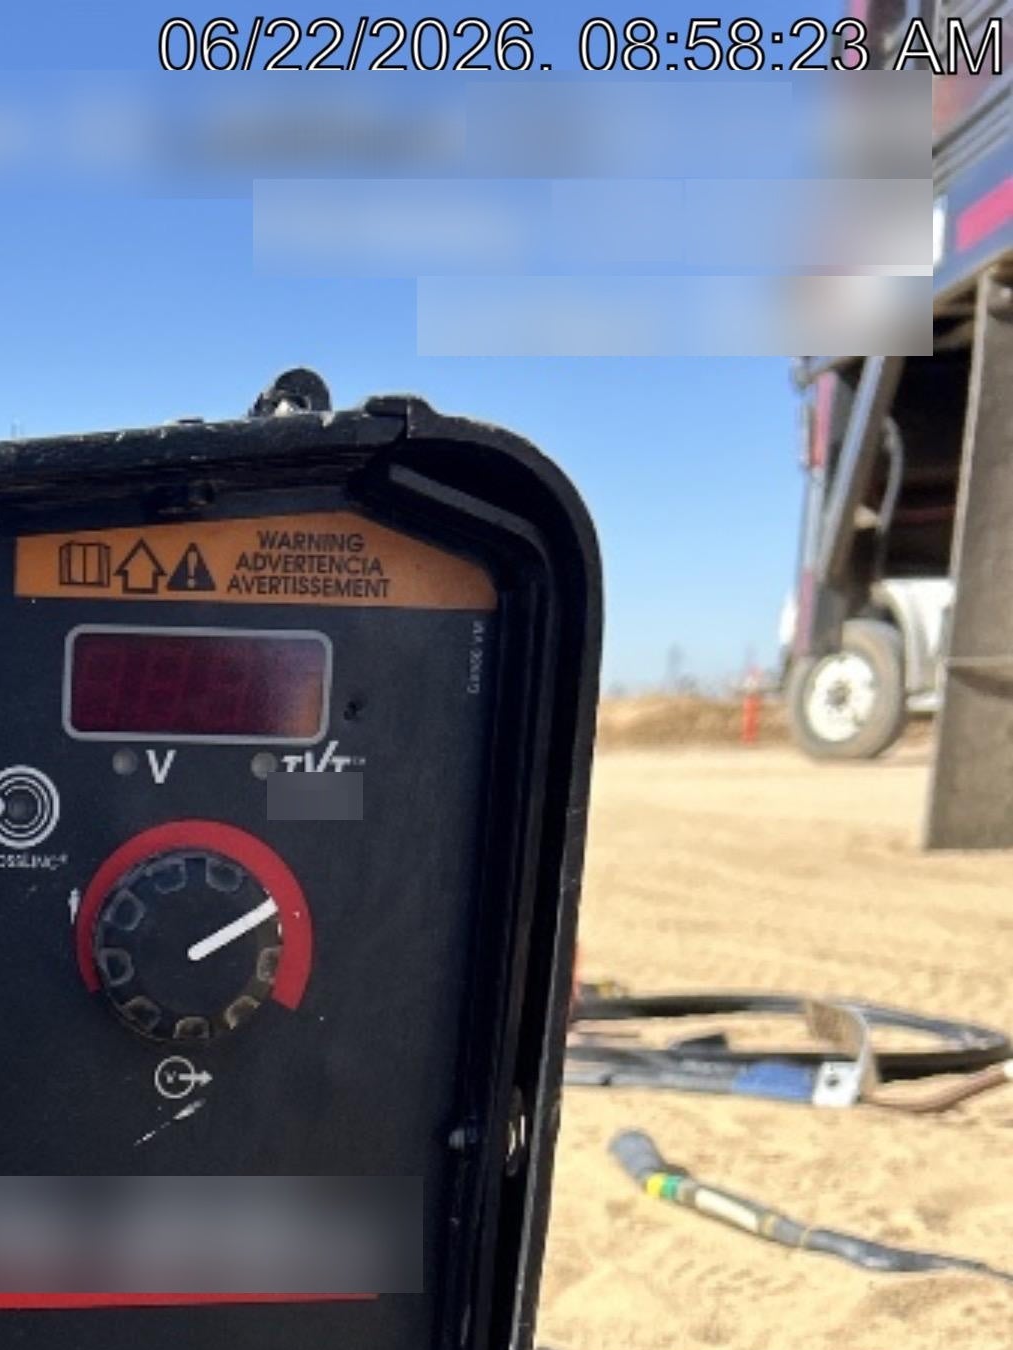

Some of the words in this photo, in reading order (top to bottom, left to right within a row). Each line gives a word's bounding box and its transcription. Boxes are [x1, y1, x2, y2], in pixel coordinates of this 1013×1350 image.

[258, 531, 364, 552] WARNING
[235, 552, 384, 577] ADVERTENCIA
[226, 575, 391, 599] AVERTISSEMENT
[145, 748, 177, 784] V
